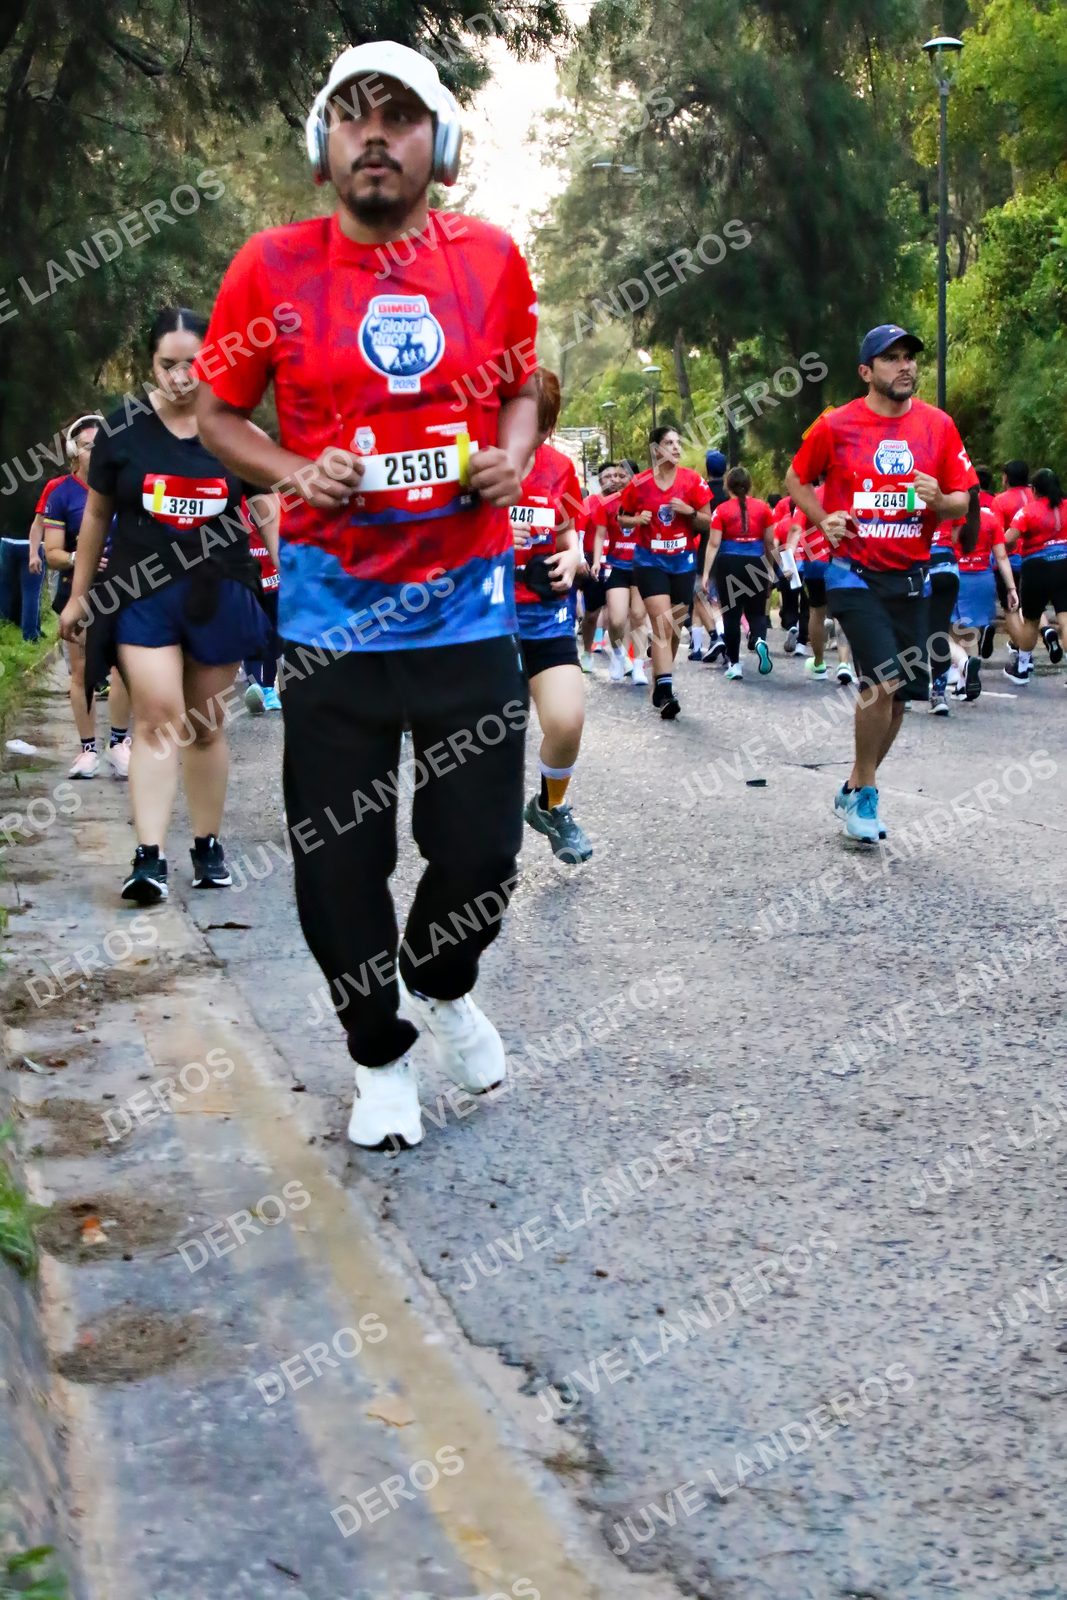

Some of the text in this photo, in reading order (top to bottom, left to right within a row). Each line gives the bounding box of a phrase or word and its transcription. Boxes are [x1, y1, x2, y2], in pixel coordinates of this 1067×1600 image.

[378, 303, 421, 313] BIMBO
[380, 318, 423, 334] Global
[372, 331, 407, 346] Race
[384, 450, 447, 486] 2536
[169, 498, 204, 515] 3291
[874, 493, 906, 508] 2849
[510, 506, 535, 523] 448
